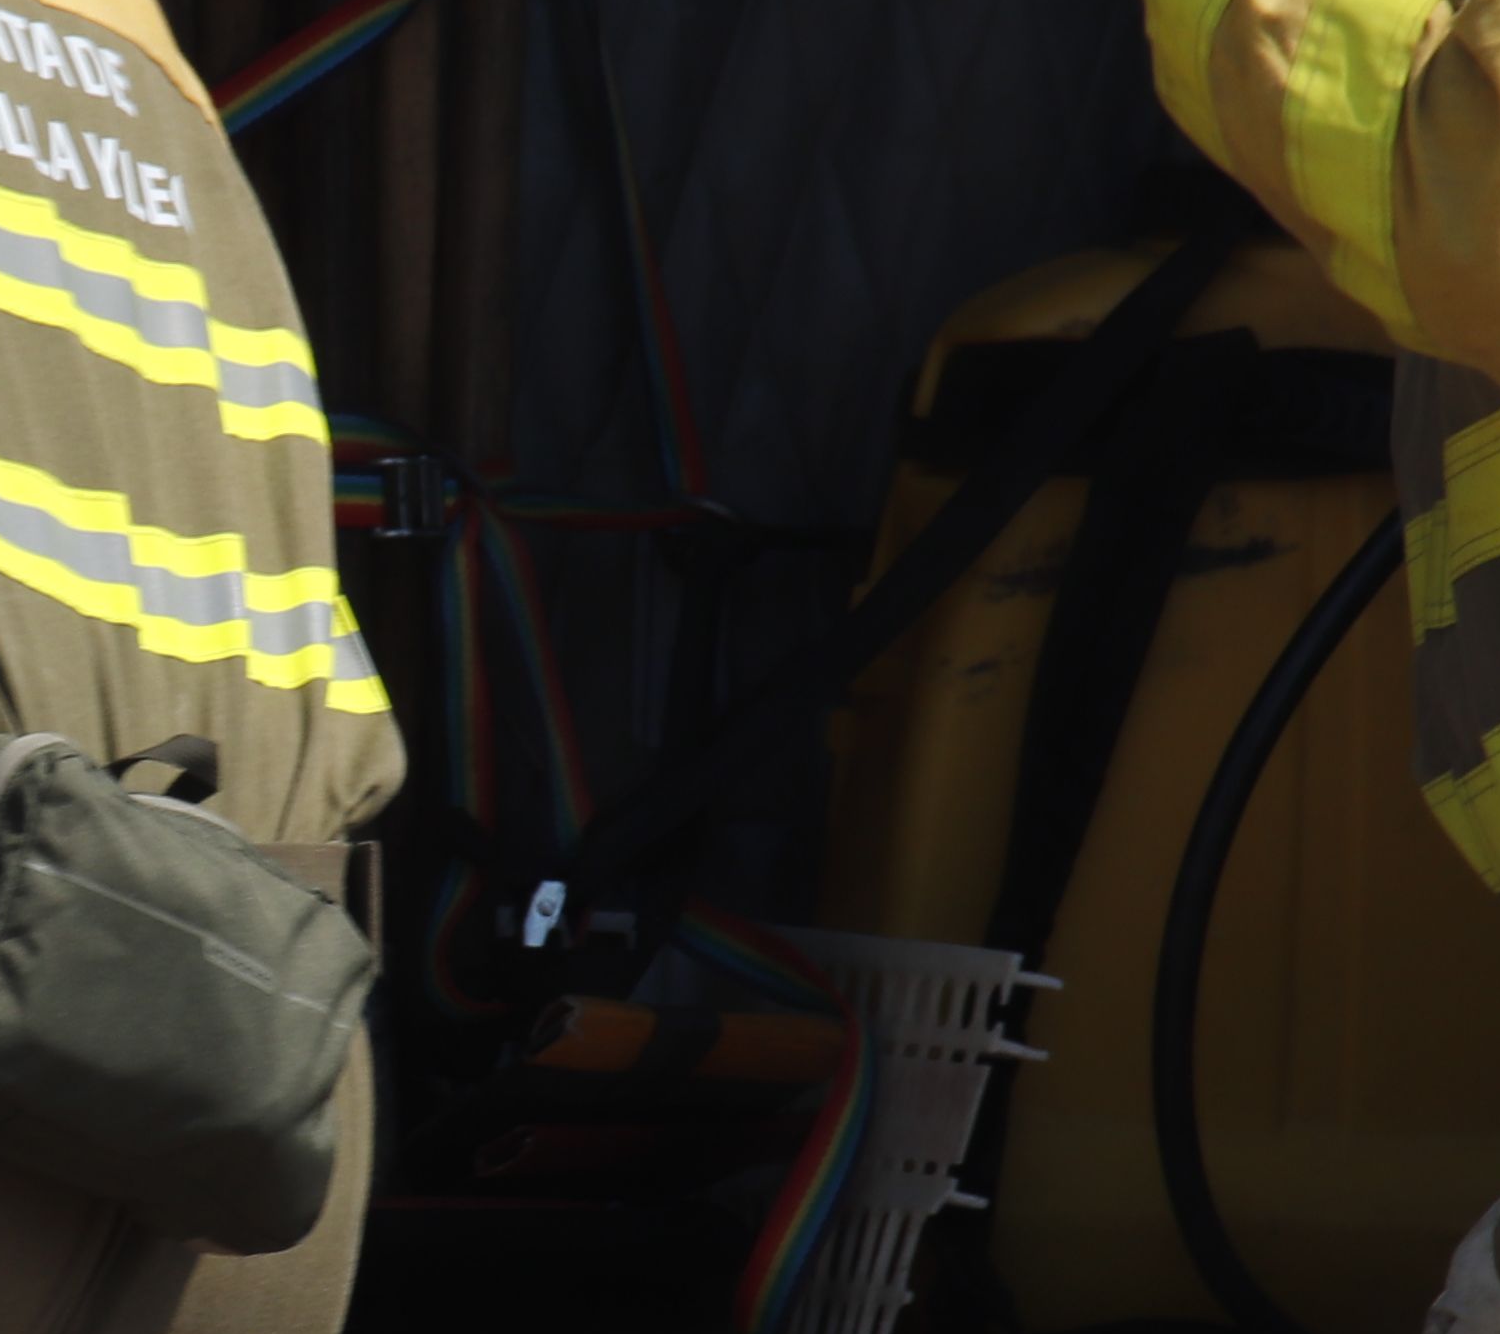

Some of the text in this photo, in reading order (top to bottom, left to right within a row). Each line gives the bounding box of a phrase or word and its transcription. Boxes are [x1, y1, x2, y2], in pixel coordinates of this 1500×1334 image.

[64, 34, 138, 117] DE
[82, 131, 123, 200] Y
[119, 149, 195, 235] LE
